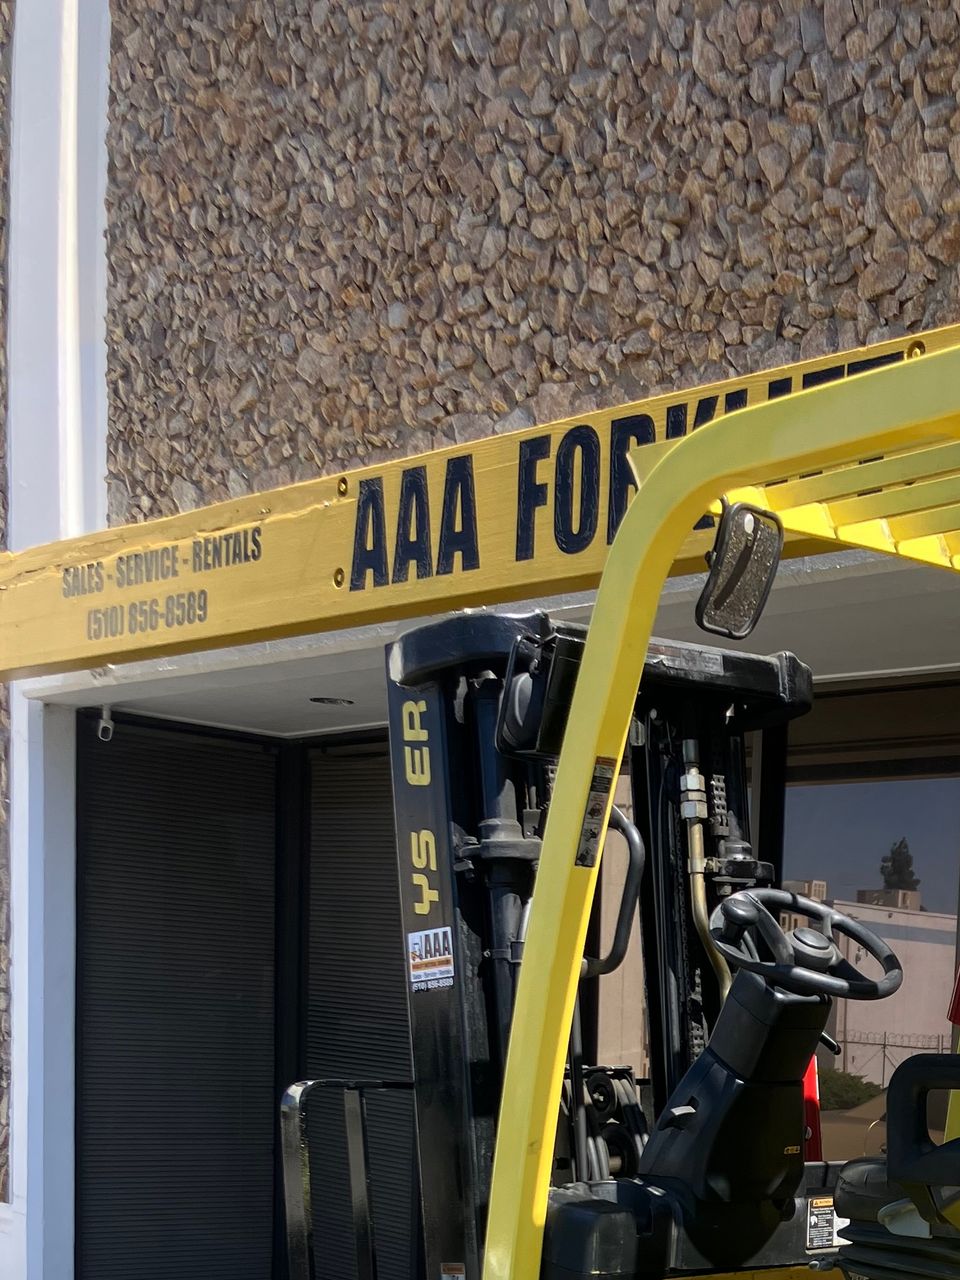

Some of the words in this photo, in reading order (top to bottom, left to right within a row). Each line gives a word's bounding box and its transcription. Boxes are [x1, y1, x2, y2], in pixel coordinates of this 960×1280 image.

[349, 453, 480, 592] AAA
[62, 562, 105, 598] SALES
[115, 544, 179, 588] SERVICE
[192, 526, 262, 573] RENTALS
[87, 604, 124, 641] (510)
[128, 589, 208, 635] 856-8589
[424, 931, 452, 960] AAA
